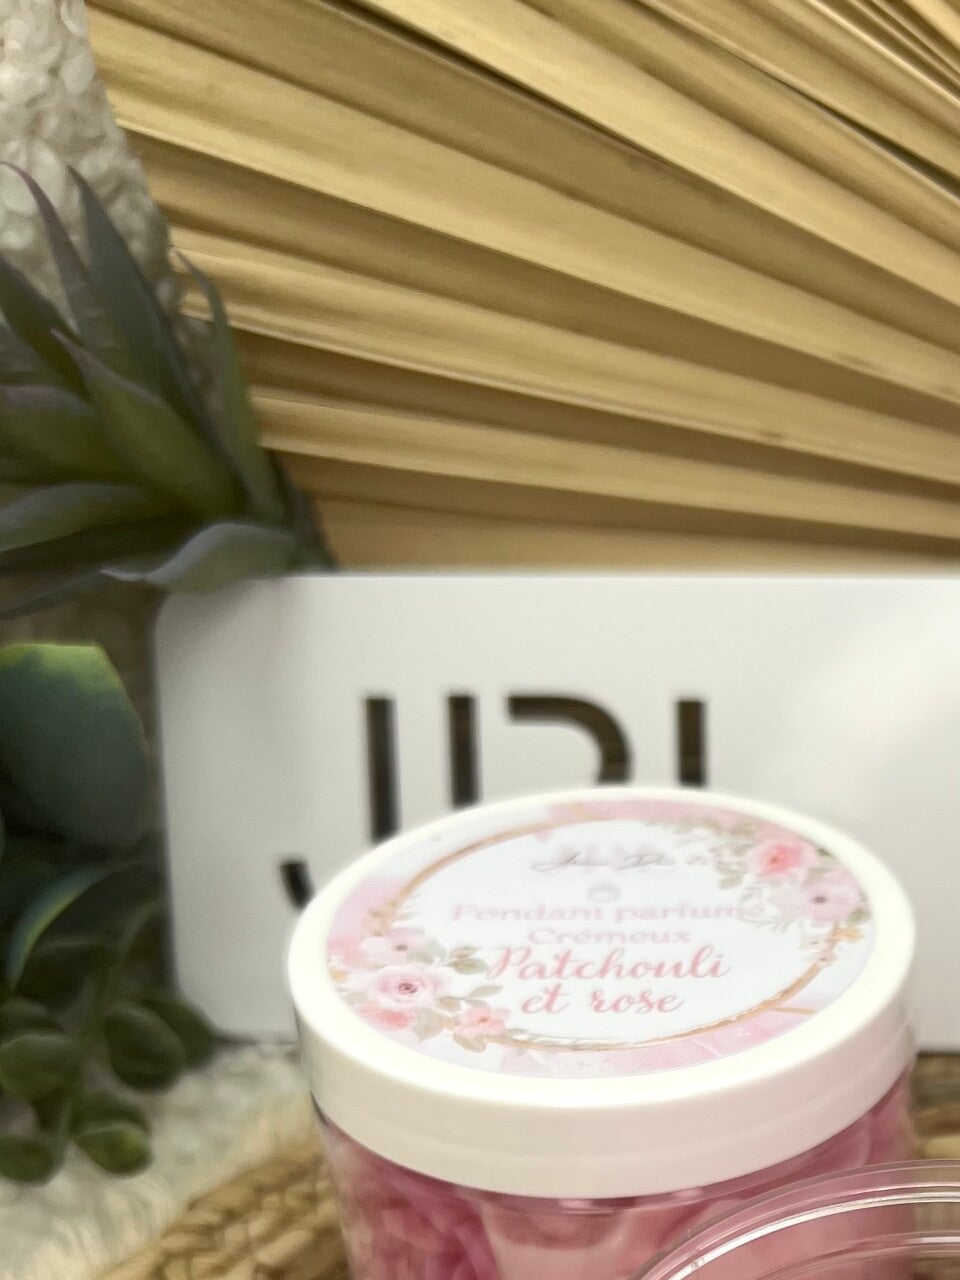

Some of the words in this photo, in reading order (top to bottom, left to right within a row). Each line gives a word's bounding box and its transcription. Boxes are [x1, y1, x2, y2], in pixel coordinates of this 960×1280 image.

[451, 903, 604, 921] Fondant
[486, 945, 731, 981] Patchouli
[520, 983, 569, 1014] et
[588, 988, 683, 1014] rose
